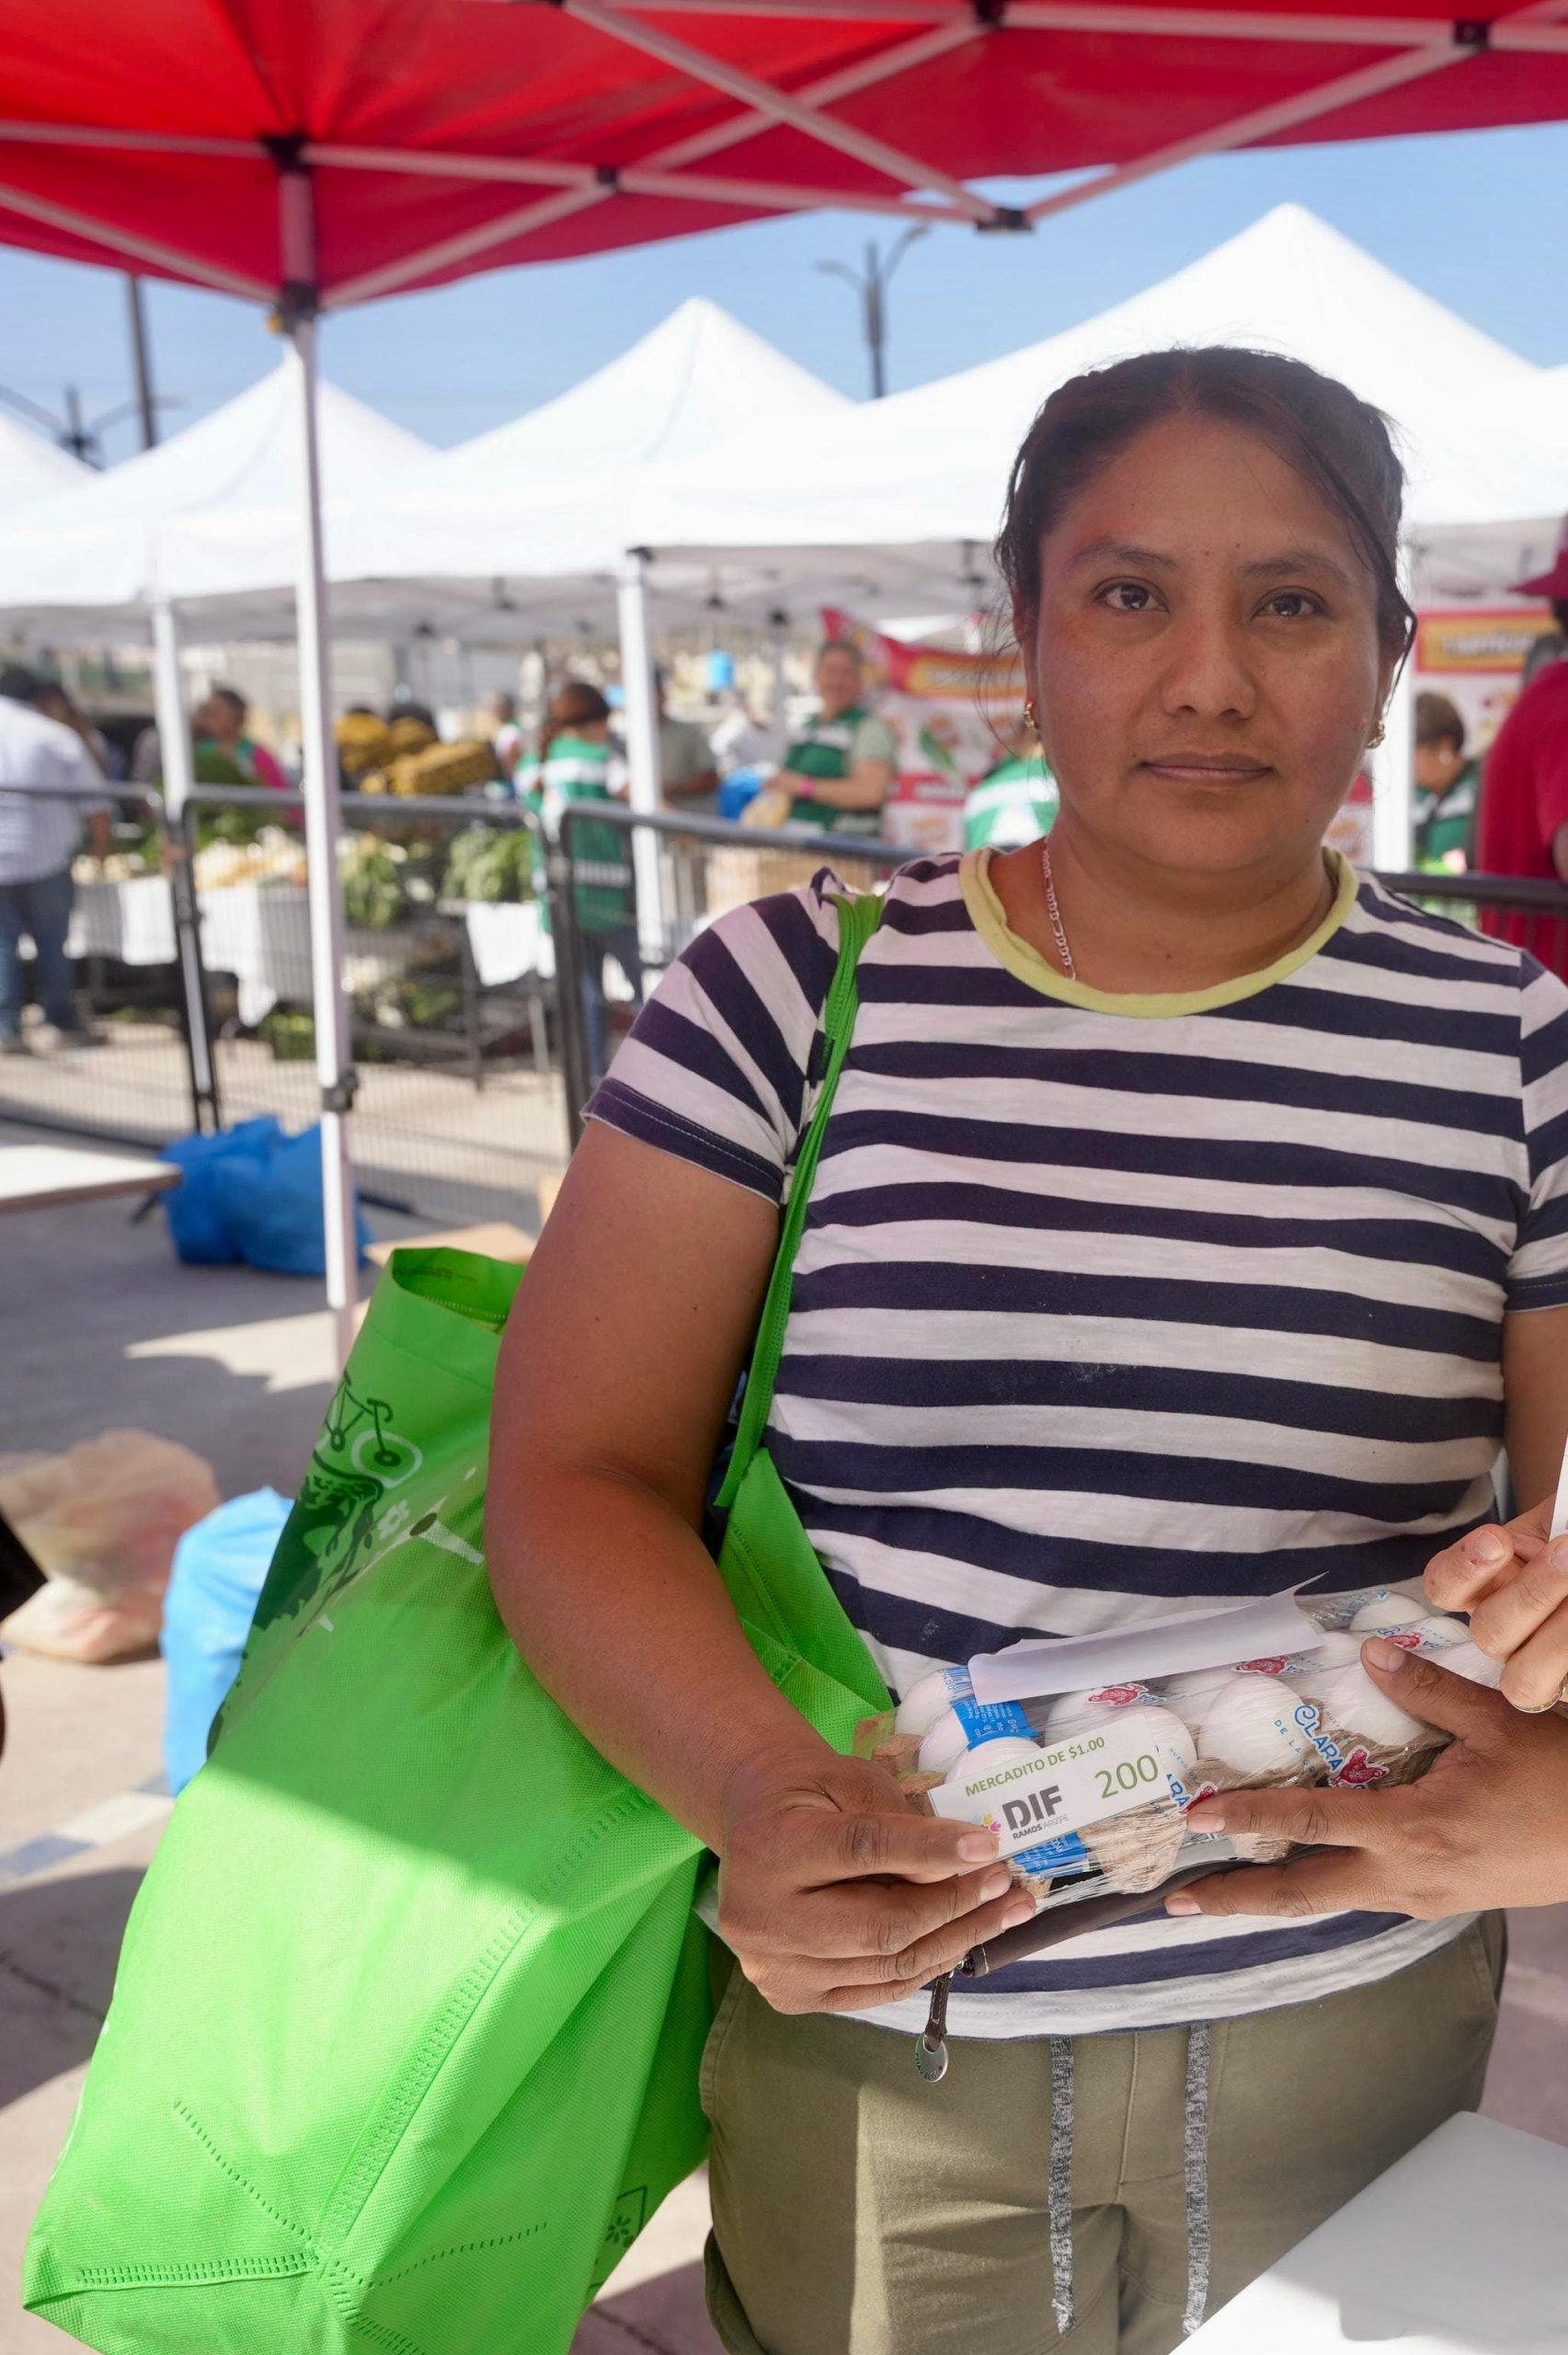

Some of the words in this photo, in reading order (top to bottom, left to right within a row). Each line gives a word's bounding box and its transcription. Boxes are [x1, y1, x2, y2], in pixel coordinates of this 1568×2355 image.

[1273, 1719, 1288, 1736] DE
[1288, 1739, 1303, 1753] LA
[1294, 1705, 1344, 1772] CLARA
[966, 1759, 1046, 1797] MERCADITO
[1048, 1752, 1066, 1766] DE
[1069, 1737, 1105, 1759] $1.00
[1094, 1754, 1159, 1799] 200
[1002, 1785, 1063, 1832] DIF
[1013, 1824, 1043, 1840] RAMOS
[1042, 1815, 1070, 1831] ARIZPE
